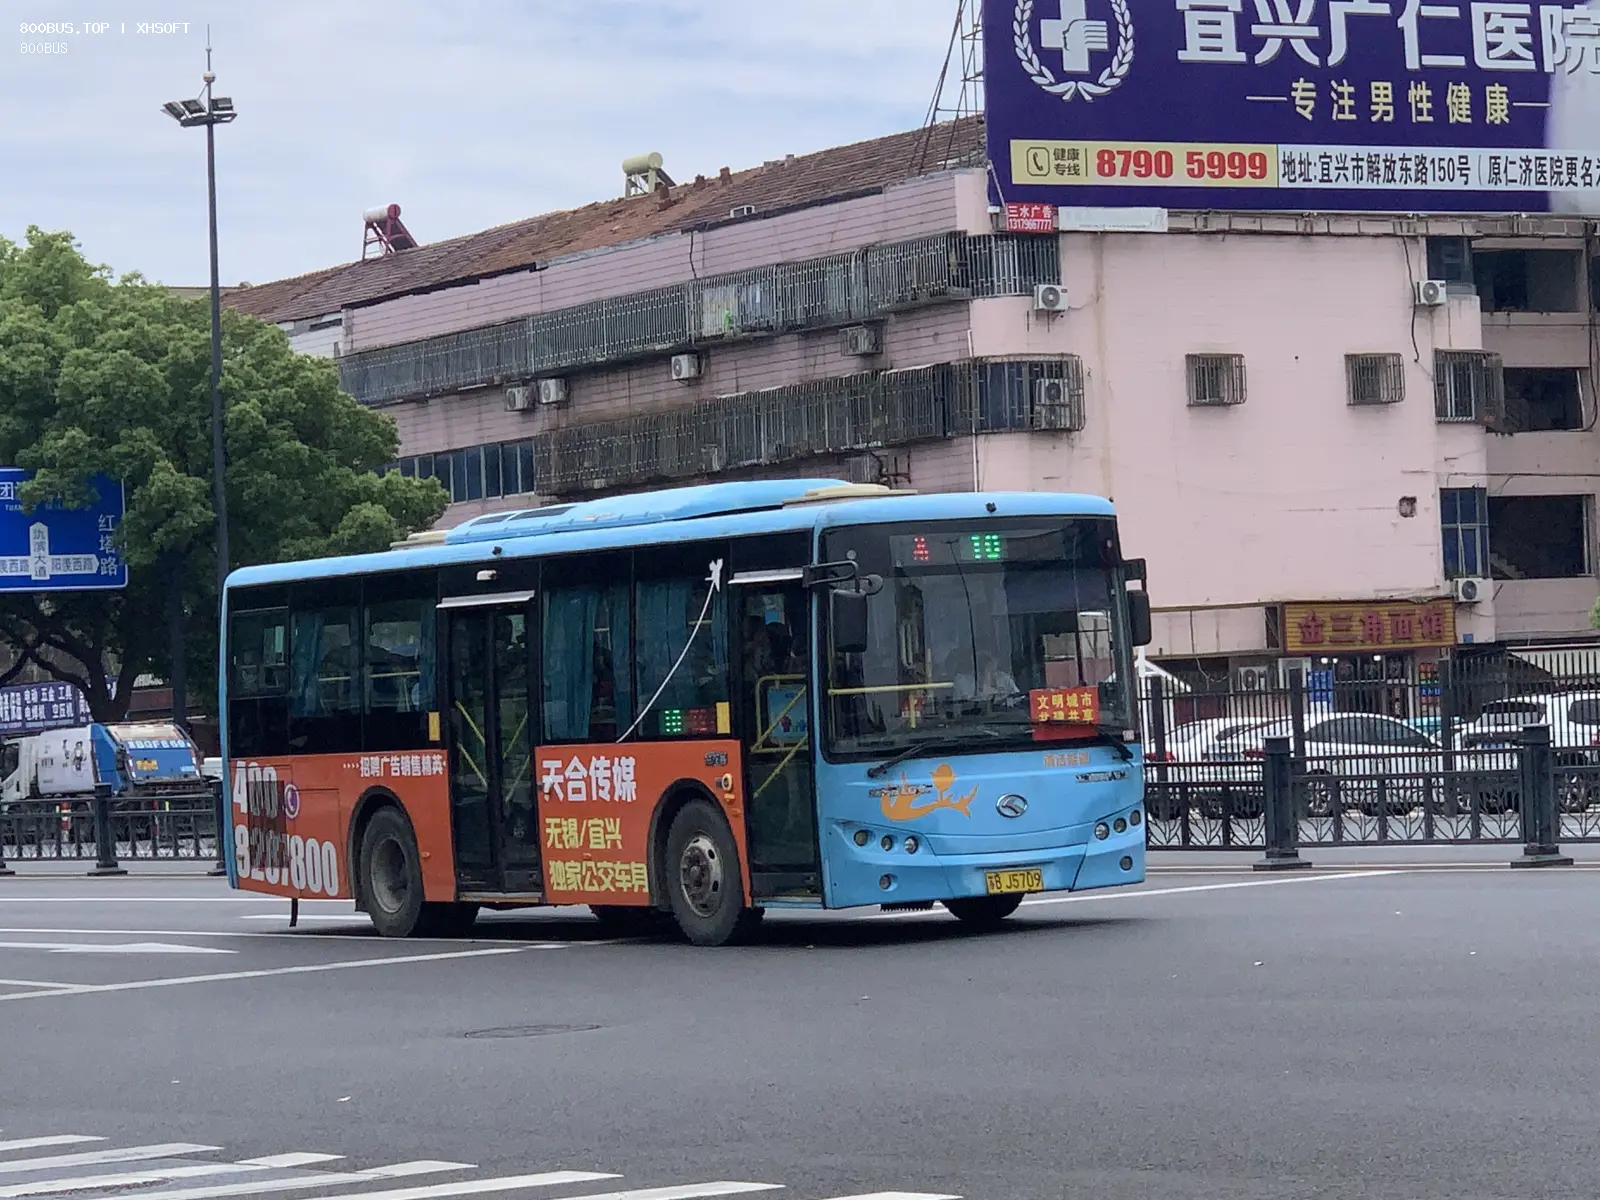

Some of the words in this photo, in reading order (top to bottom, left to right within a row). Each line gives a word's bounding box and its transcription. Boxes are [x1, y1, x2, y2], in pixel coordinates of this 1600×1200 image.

[1053, 147, 1080, 161] 健康
[1096, 149, 1173, 178] 8790
[1186, 151, 1267, 180] 5999
[1053, 162, 1080, 177] 专线
[1008, 205, 1052, 218] 三水广告
[98, 513, 118, 577] 红塔路
[1299, 604, 1446, 644] 金三角面馆
[1037, 692, 1092, 710] 文明城市
[360, 754, 443, 777] 招聘广告销售精英
[541, 755, 637, 802] 天合传媒
[545, 818, 622, 849] 无锡/宜兴
[1006, 872, 1041, 889] J5709
